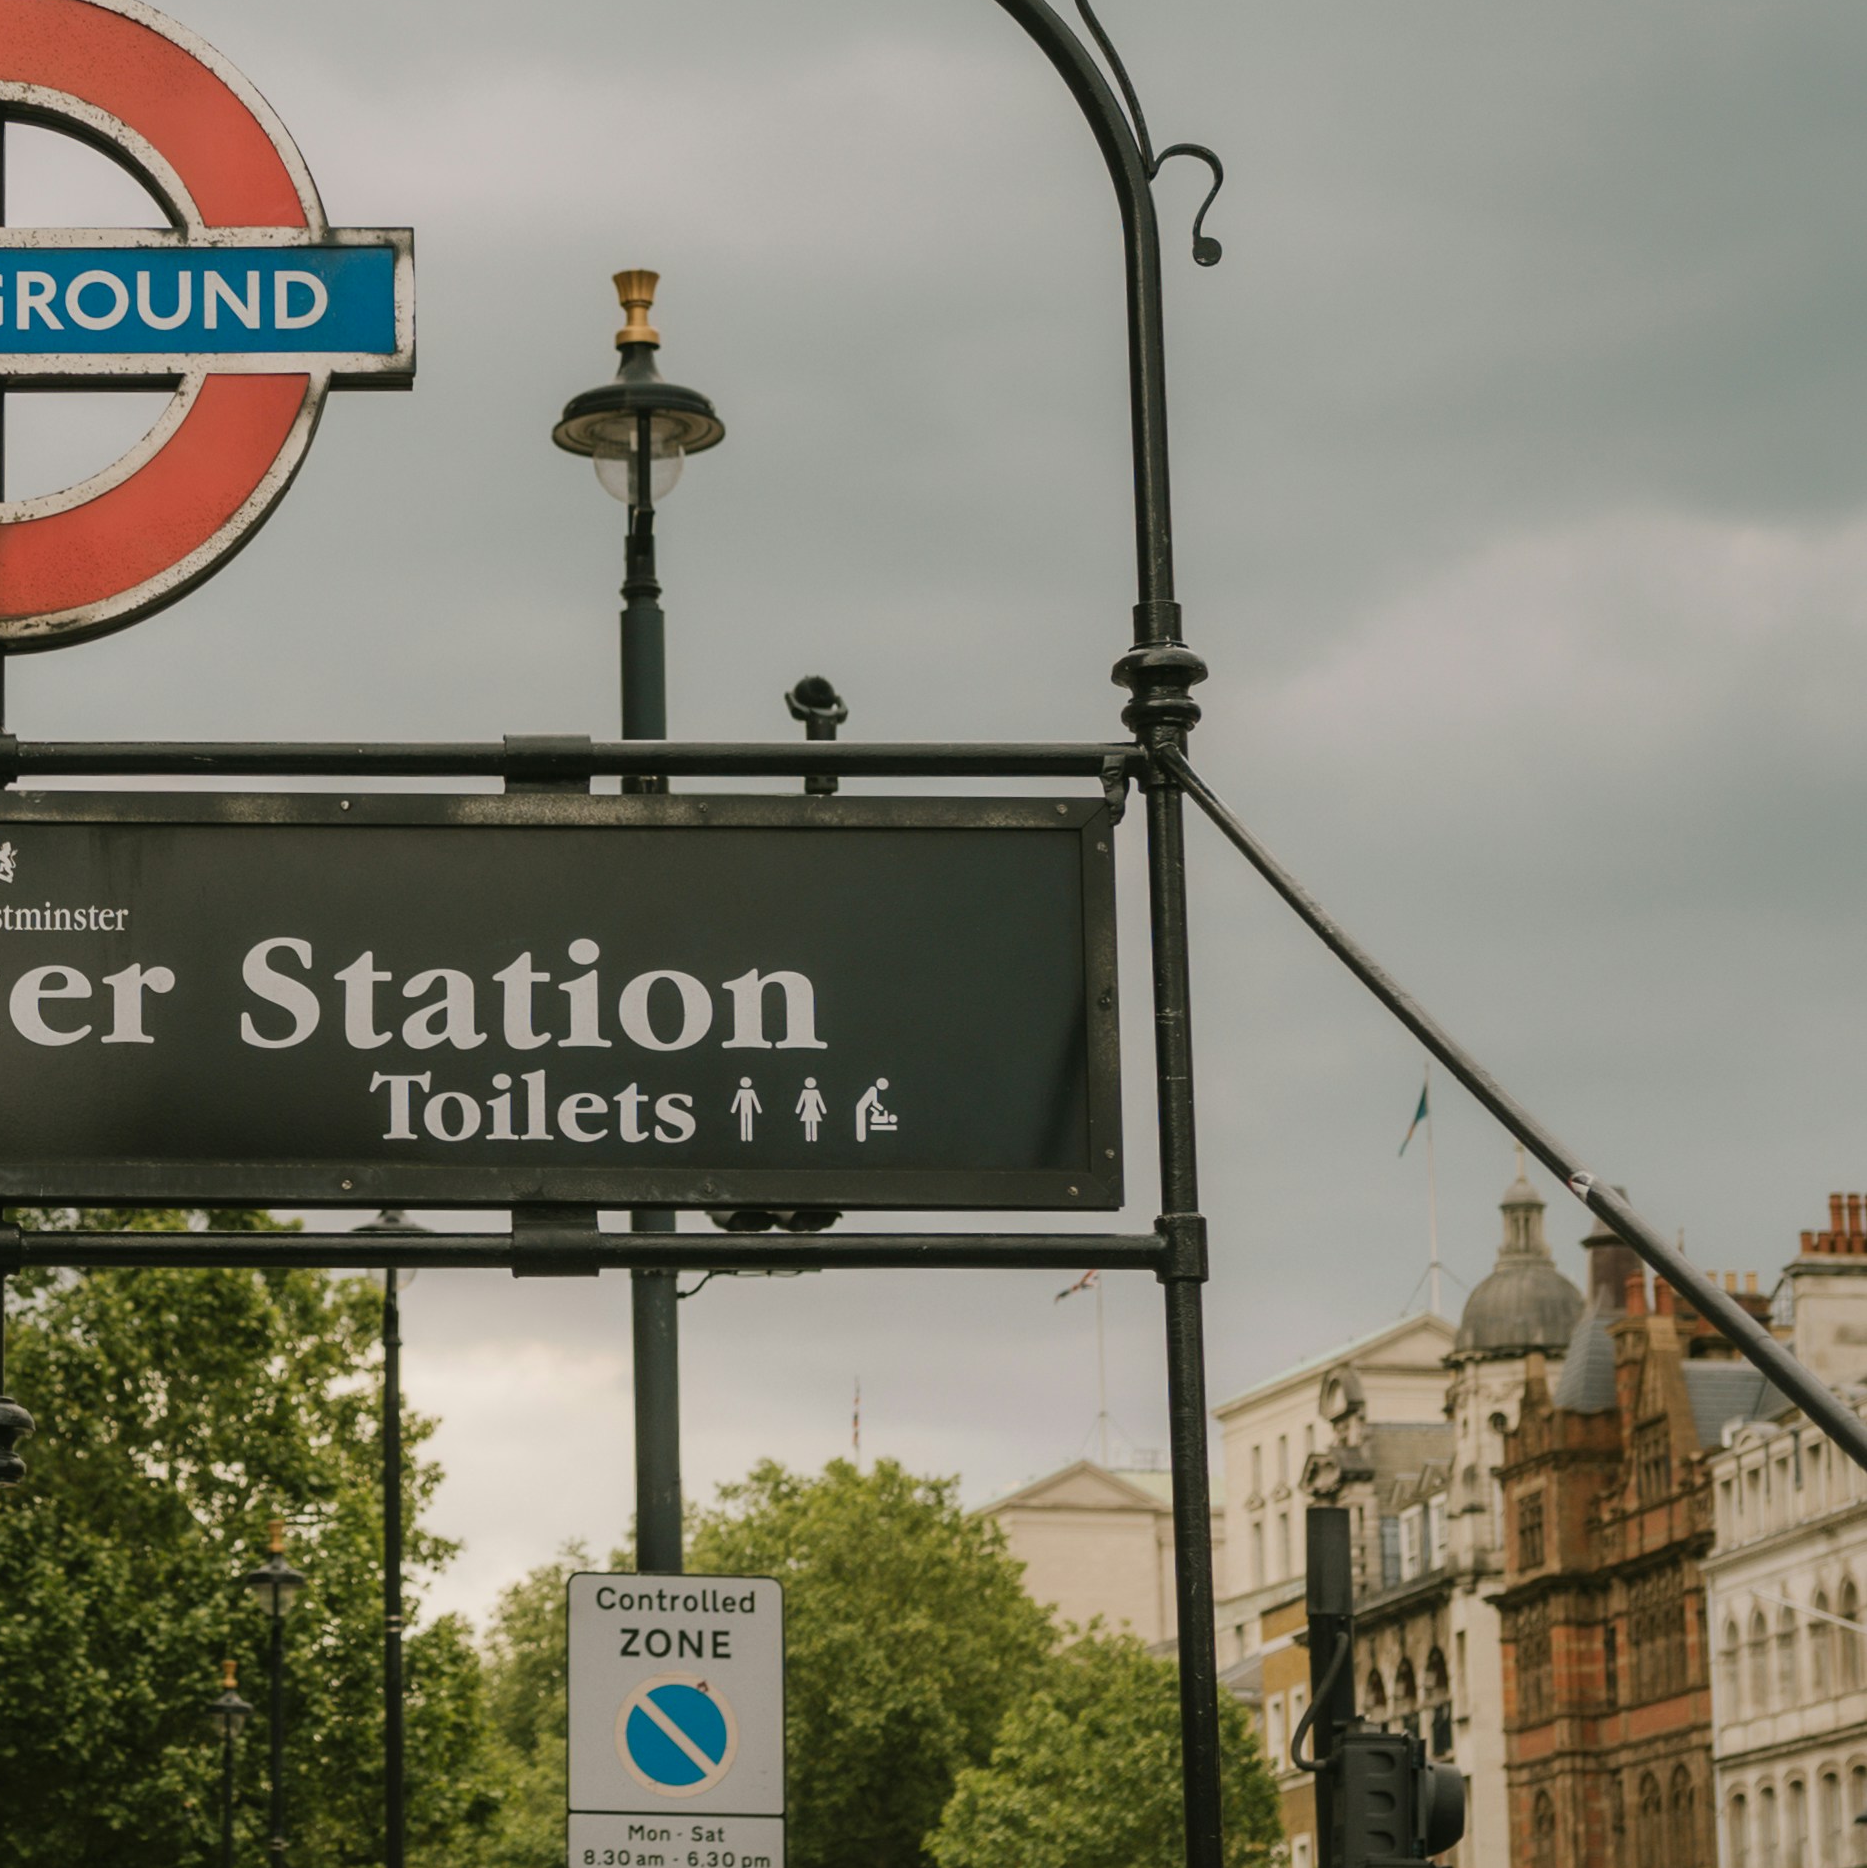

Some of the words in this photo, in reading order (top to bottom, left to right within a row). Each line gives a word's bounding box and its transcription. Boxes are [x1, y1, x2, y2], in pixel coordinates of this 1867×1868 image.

[240, 936, 828, 1052] Station
[369, 1068, 696, 1144] Toilets
[595, 1586, 755, 1614] Controlled
[620, 1627, 732, 1659] ZONE
[628, 1824, 671, 1842] Mon
[691, 1825, 725, 1843] Sat
[583, 1848, 631, 1867] 8.30
[635, 1853, 665, 1867] am
[686, 1850, 736, 1868] 6.30
